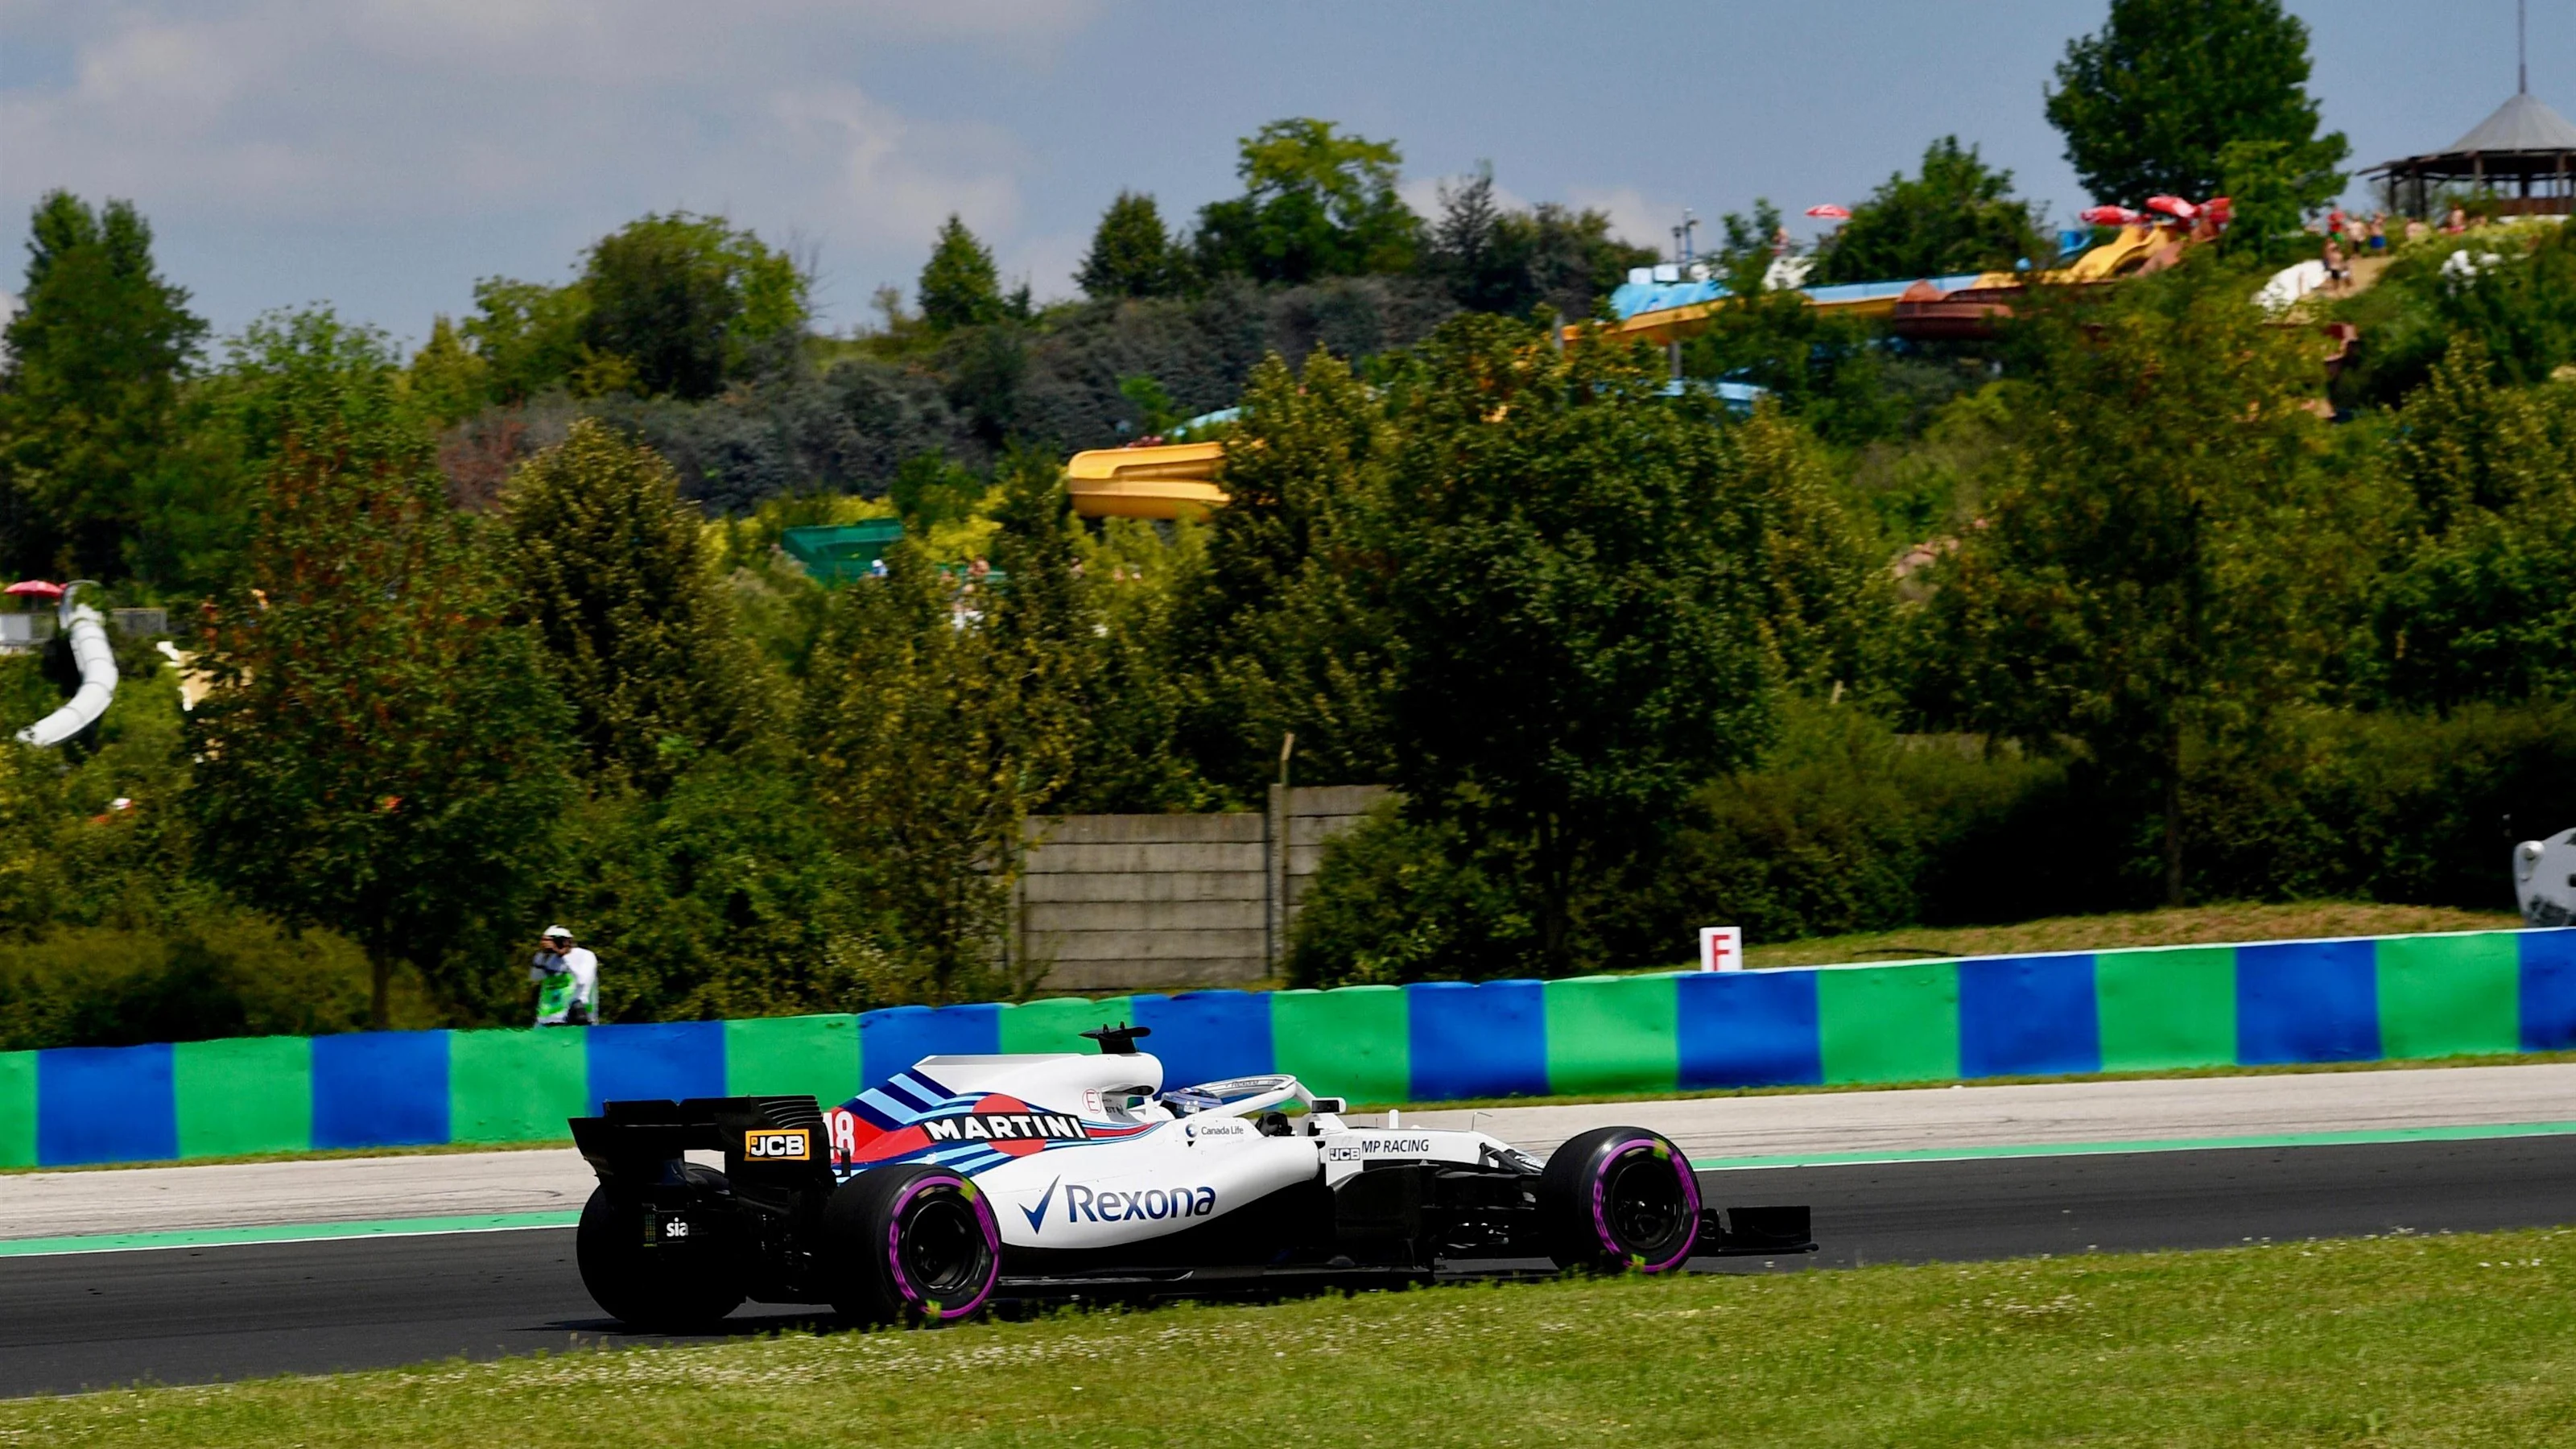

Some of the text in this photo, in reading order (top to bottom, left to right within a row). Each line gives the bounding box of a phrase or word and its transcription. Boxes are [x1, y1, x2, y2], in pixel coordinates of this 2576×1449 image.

[1711, 935, 1731, 971] F
[924, 1115, 1087, 1140] MARTINI
[1201, 1126, 1244, 1135] Canada Life
[751, 1136, 804, 1156] JCB
[1330, 1148, 1360, 1161] JCB
[1383, 1139, 1429, 1152] RACING
[1065, 1185, 1216, 1223] Rexona
[666, 1217, 688, 1237] sia
